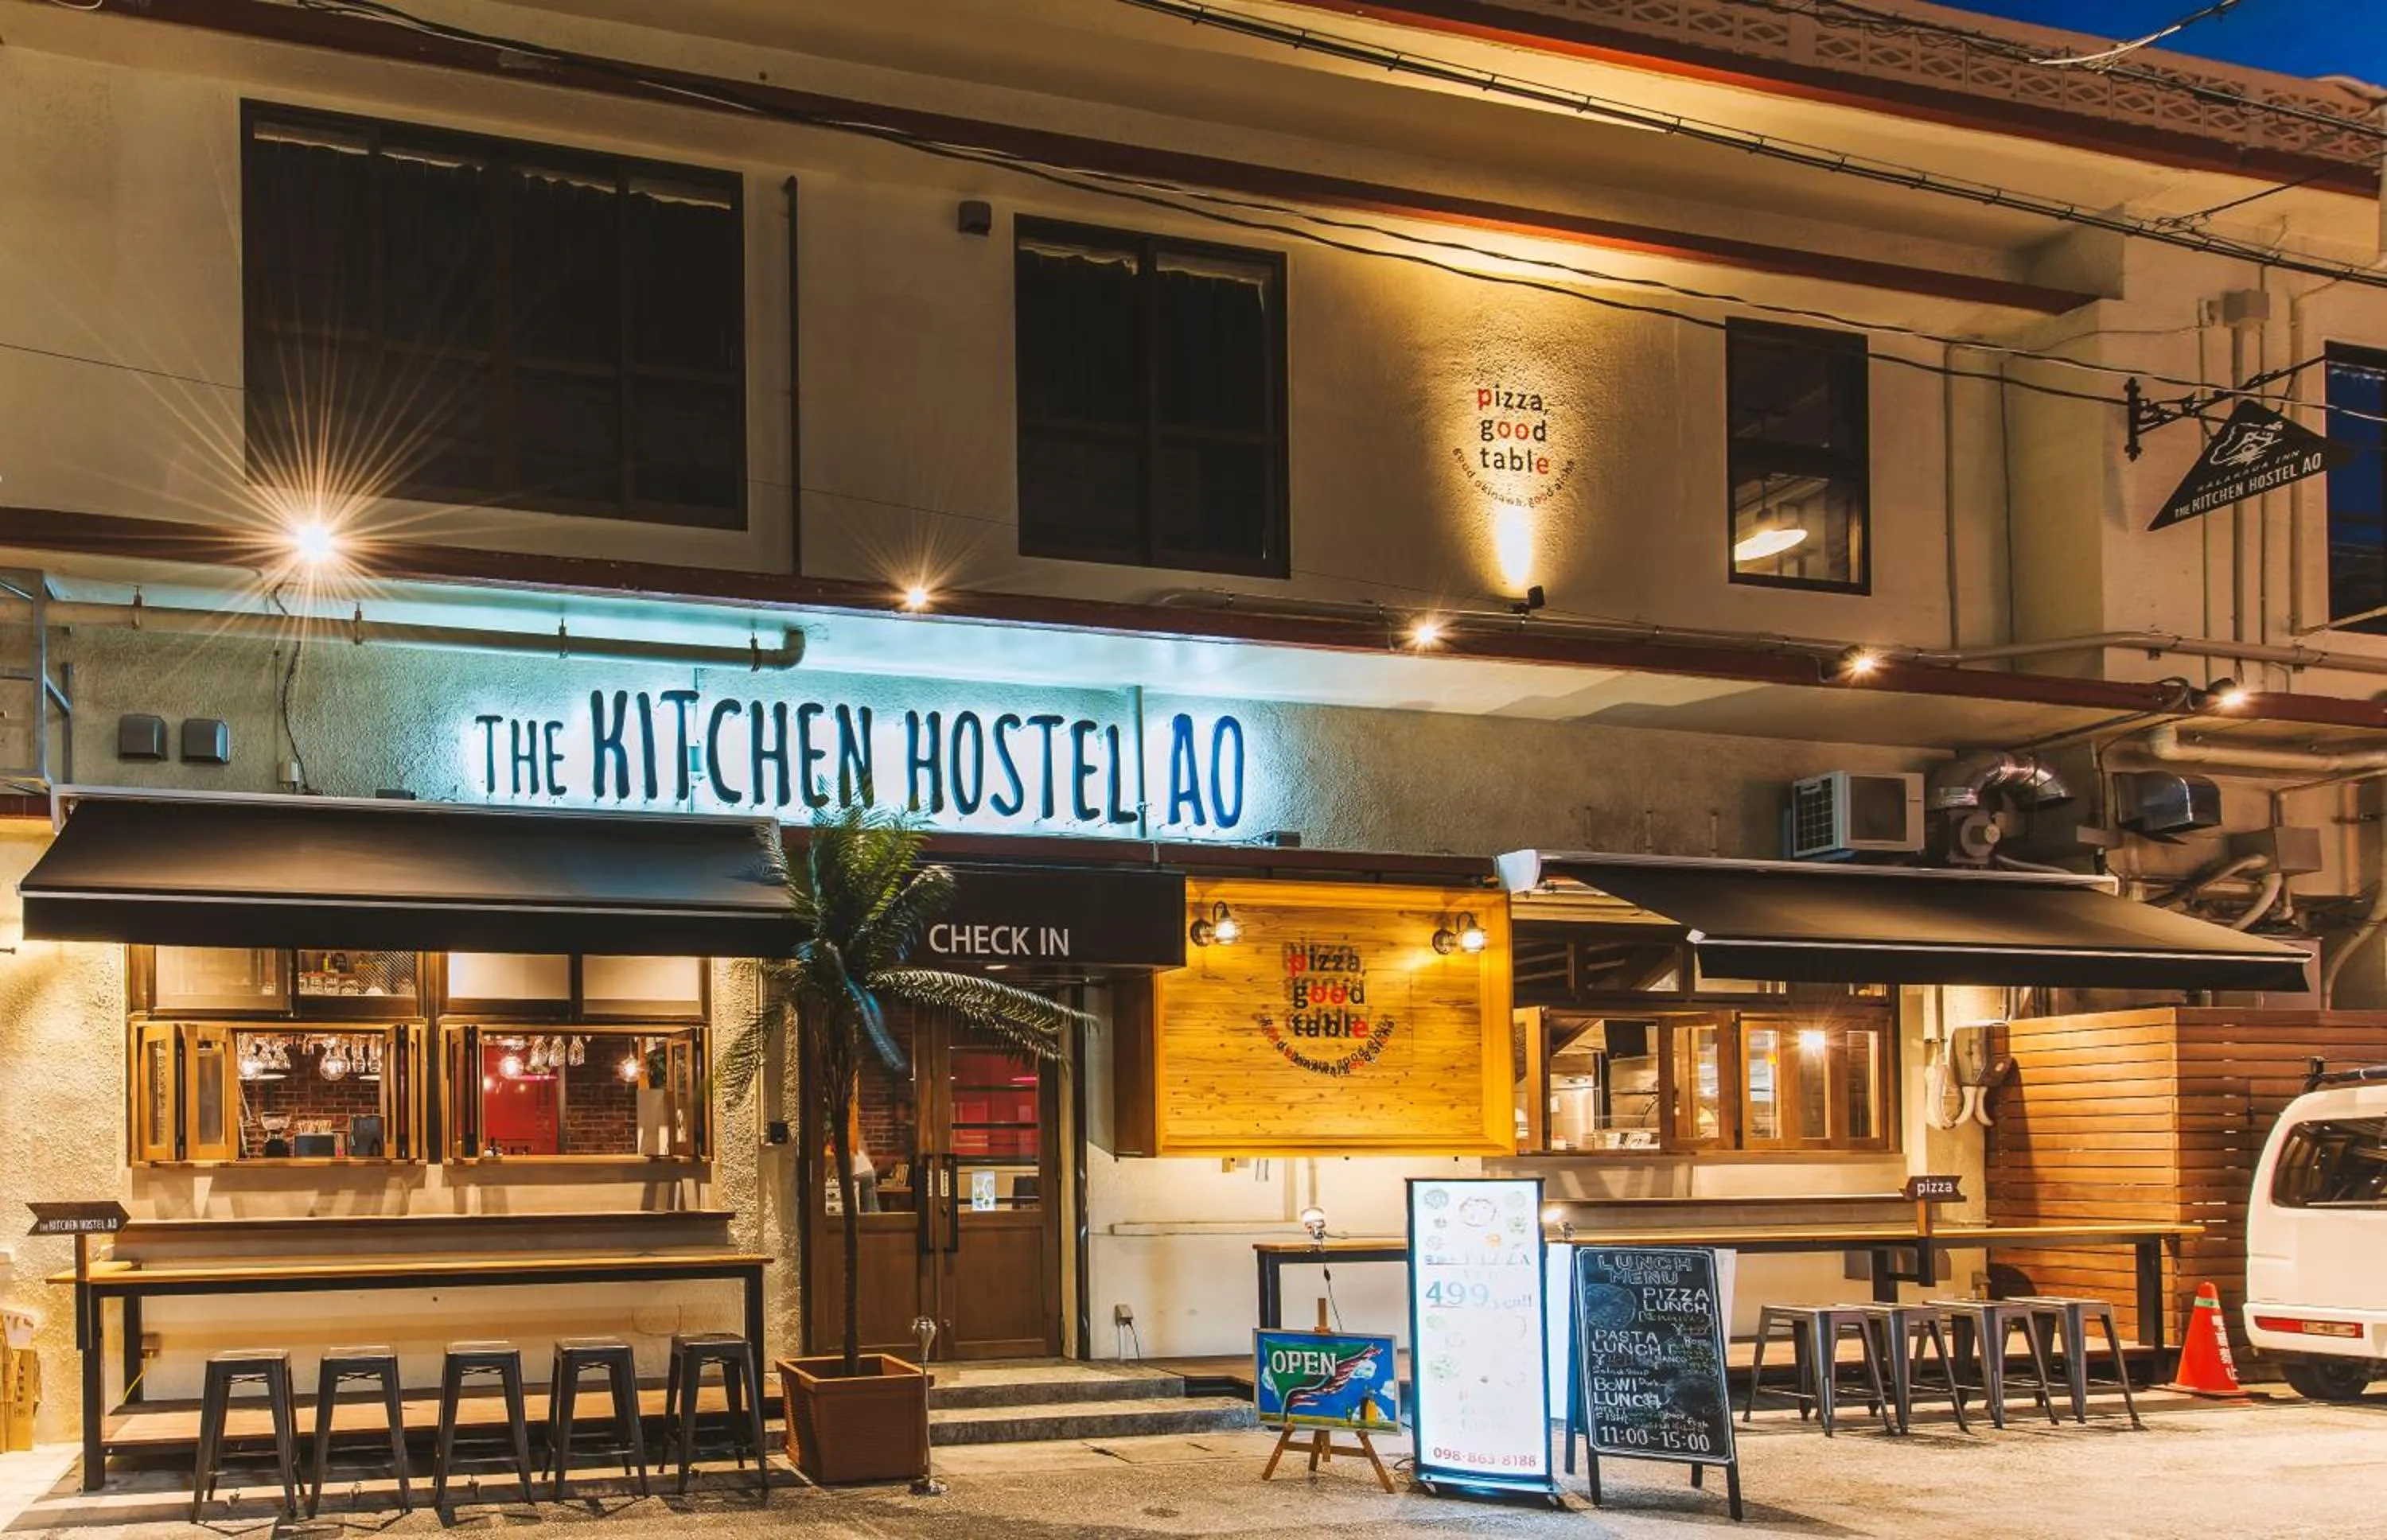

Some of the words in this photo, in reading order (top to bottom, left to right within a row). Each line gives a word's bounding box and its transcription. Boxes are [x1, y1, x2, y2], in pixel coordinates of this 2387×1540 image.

[1480, 419, 1546, 442] good
[1480, 447, 1549, 475] table
[2174, 506, 2190, 518] THE
[2192, 482, 2244, 513] KITCHEN
[2249, 464, 2298, 492] HOSTEL
[2302, 453, 2322, 474] AO
[1528, 487, 1554, 508] good
[475, 714, 567, 796] THE
[590, 689, 874, 810] KITCHEN
[905, 710, 1139, 825] HOSTEL
[1168, 712, 1245, 828] AO
[929, 924, 1030, 956] CHECK
[1040, 928, 1069, 956] IN
[1292, 981, 1365, 1009] good
[1292, 1012, 1369, 1039] table
[1917, 1178, 1953, 1196] pizza
[1598, 1254, 1692, 1271] LUNCH
[1610, 1270, 1679, 1285] MENU
[1643, 1287, 1710, 1302] PIZZA
[1643, 1300, 1708, 1314] LUNCH
[1595, 1329, 1658, 1344] PASTA
[1592, 1341, 1661, 1355] LUNCH
[1272, 1350, 1337, 1377] OPEN
[1594, 1391, 1661, 1409] LUNCH
